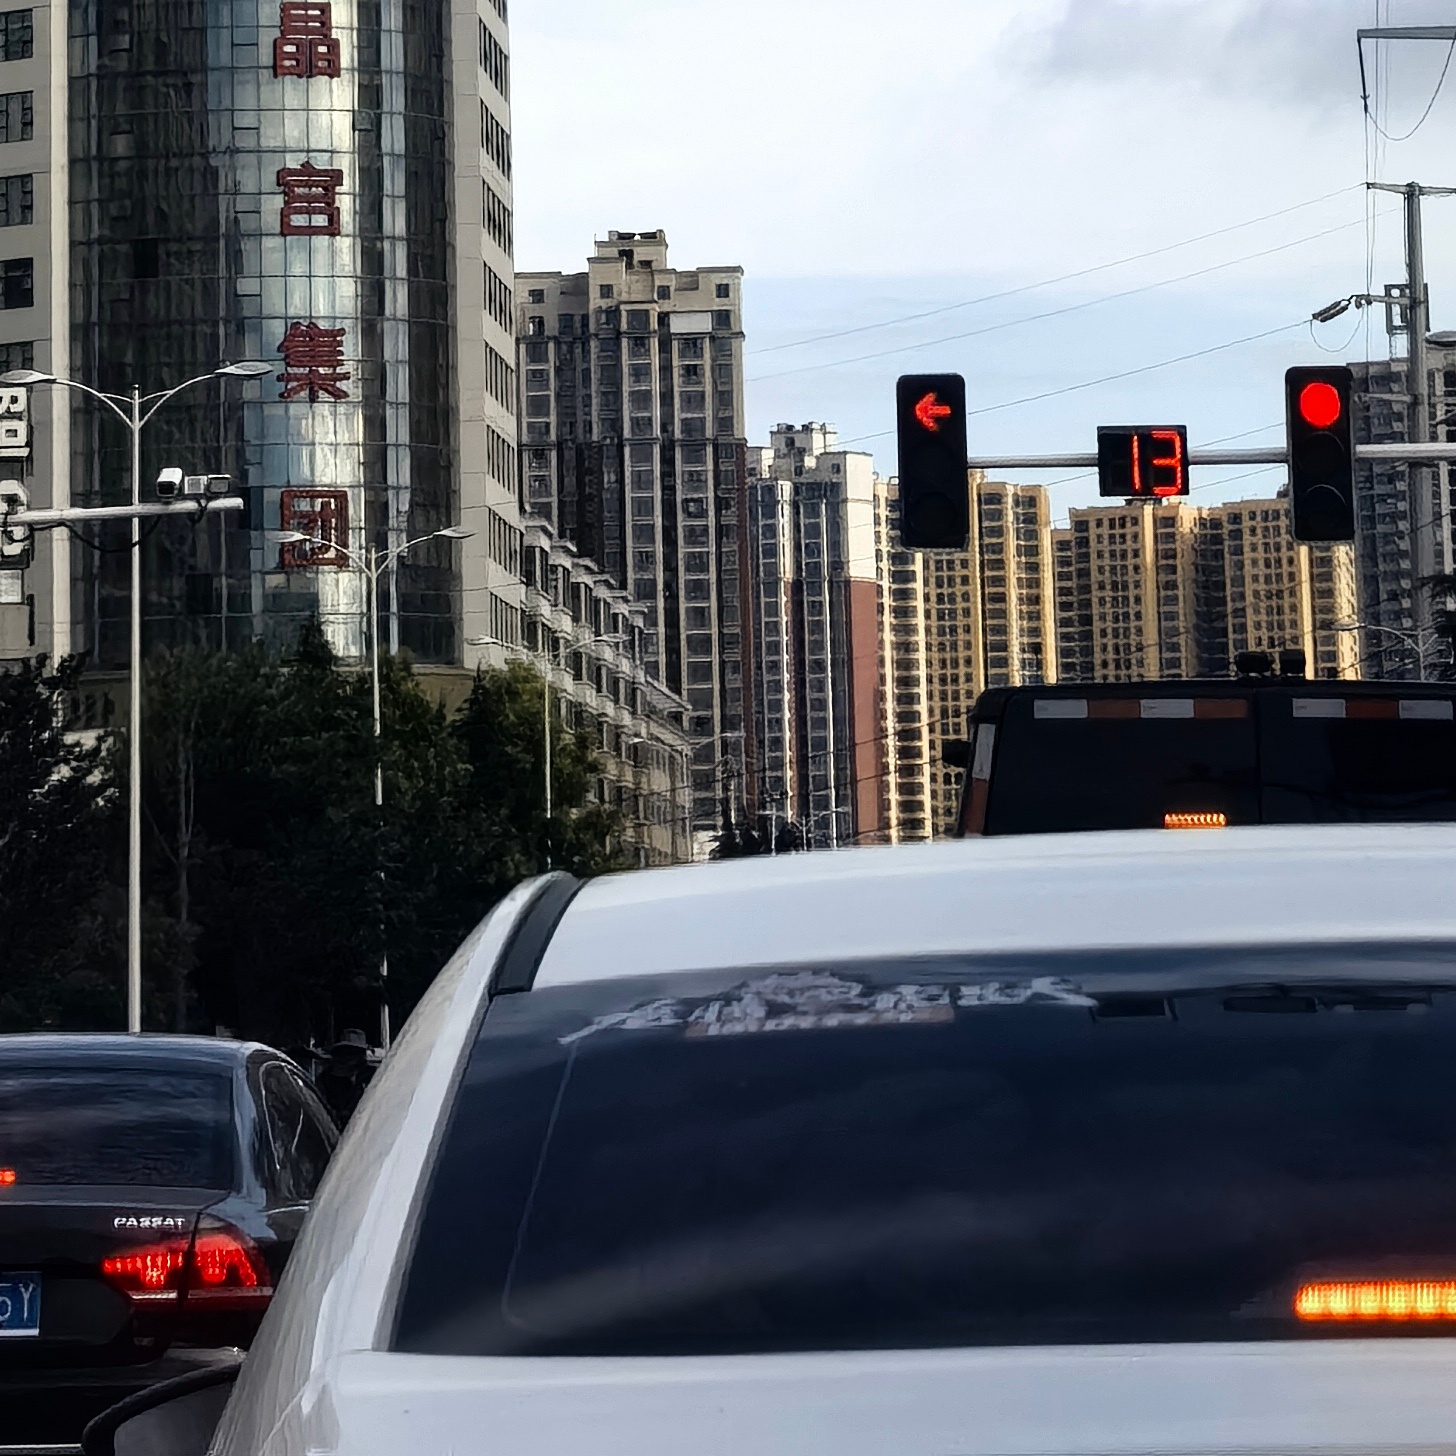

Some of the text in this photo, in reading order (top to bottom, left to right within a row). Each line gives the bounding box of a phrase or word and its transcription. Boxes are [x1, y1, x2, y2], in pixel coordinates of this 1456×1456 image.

[273, 1, 350, 568] 晶宫集团
[1132, 431, 1182, 495] 13
